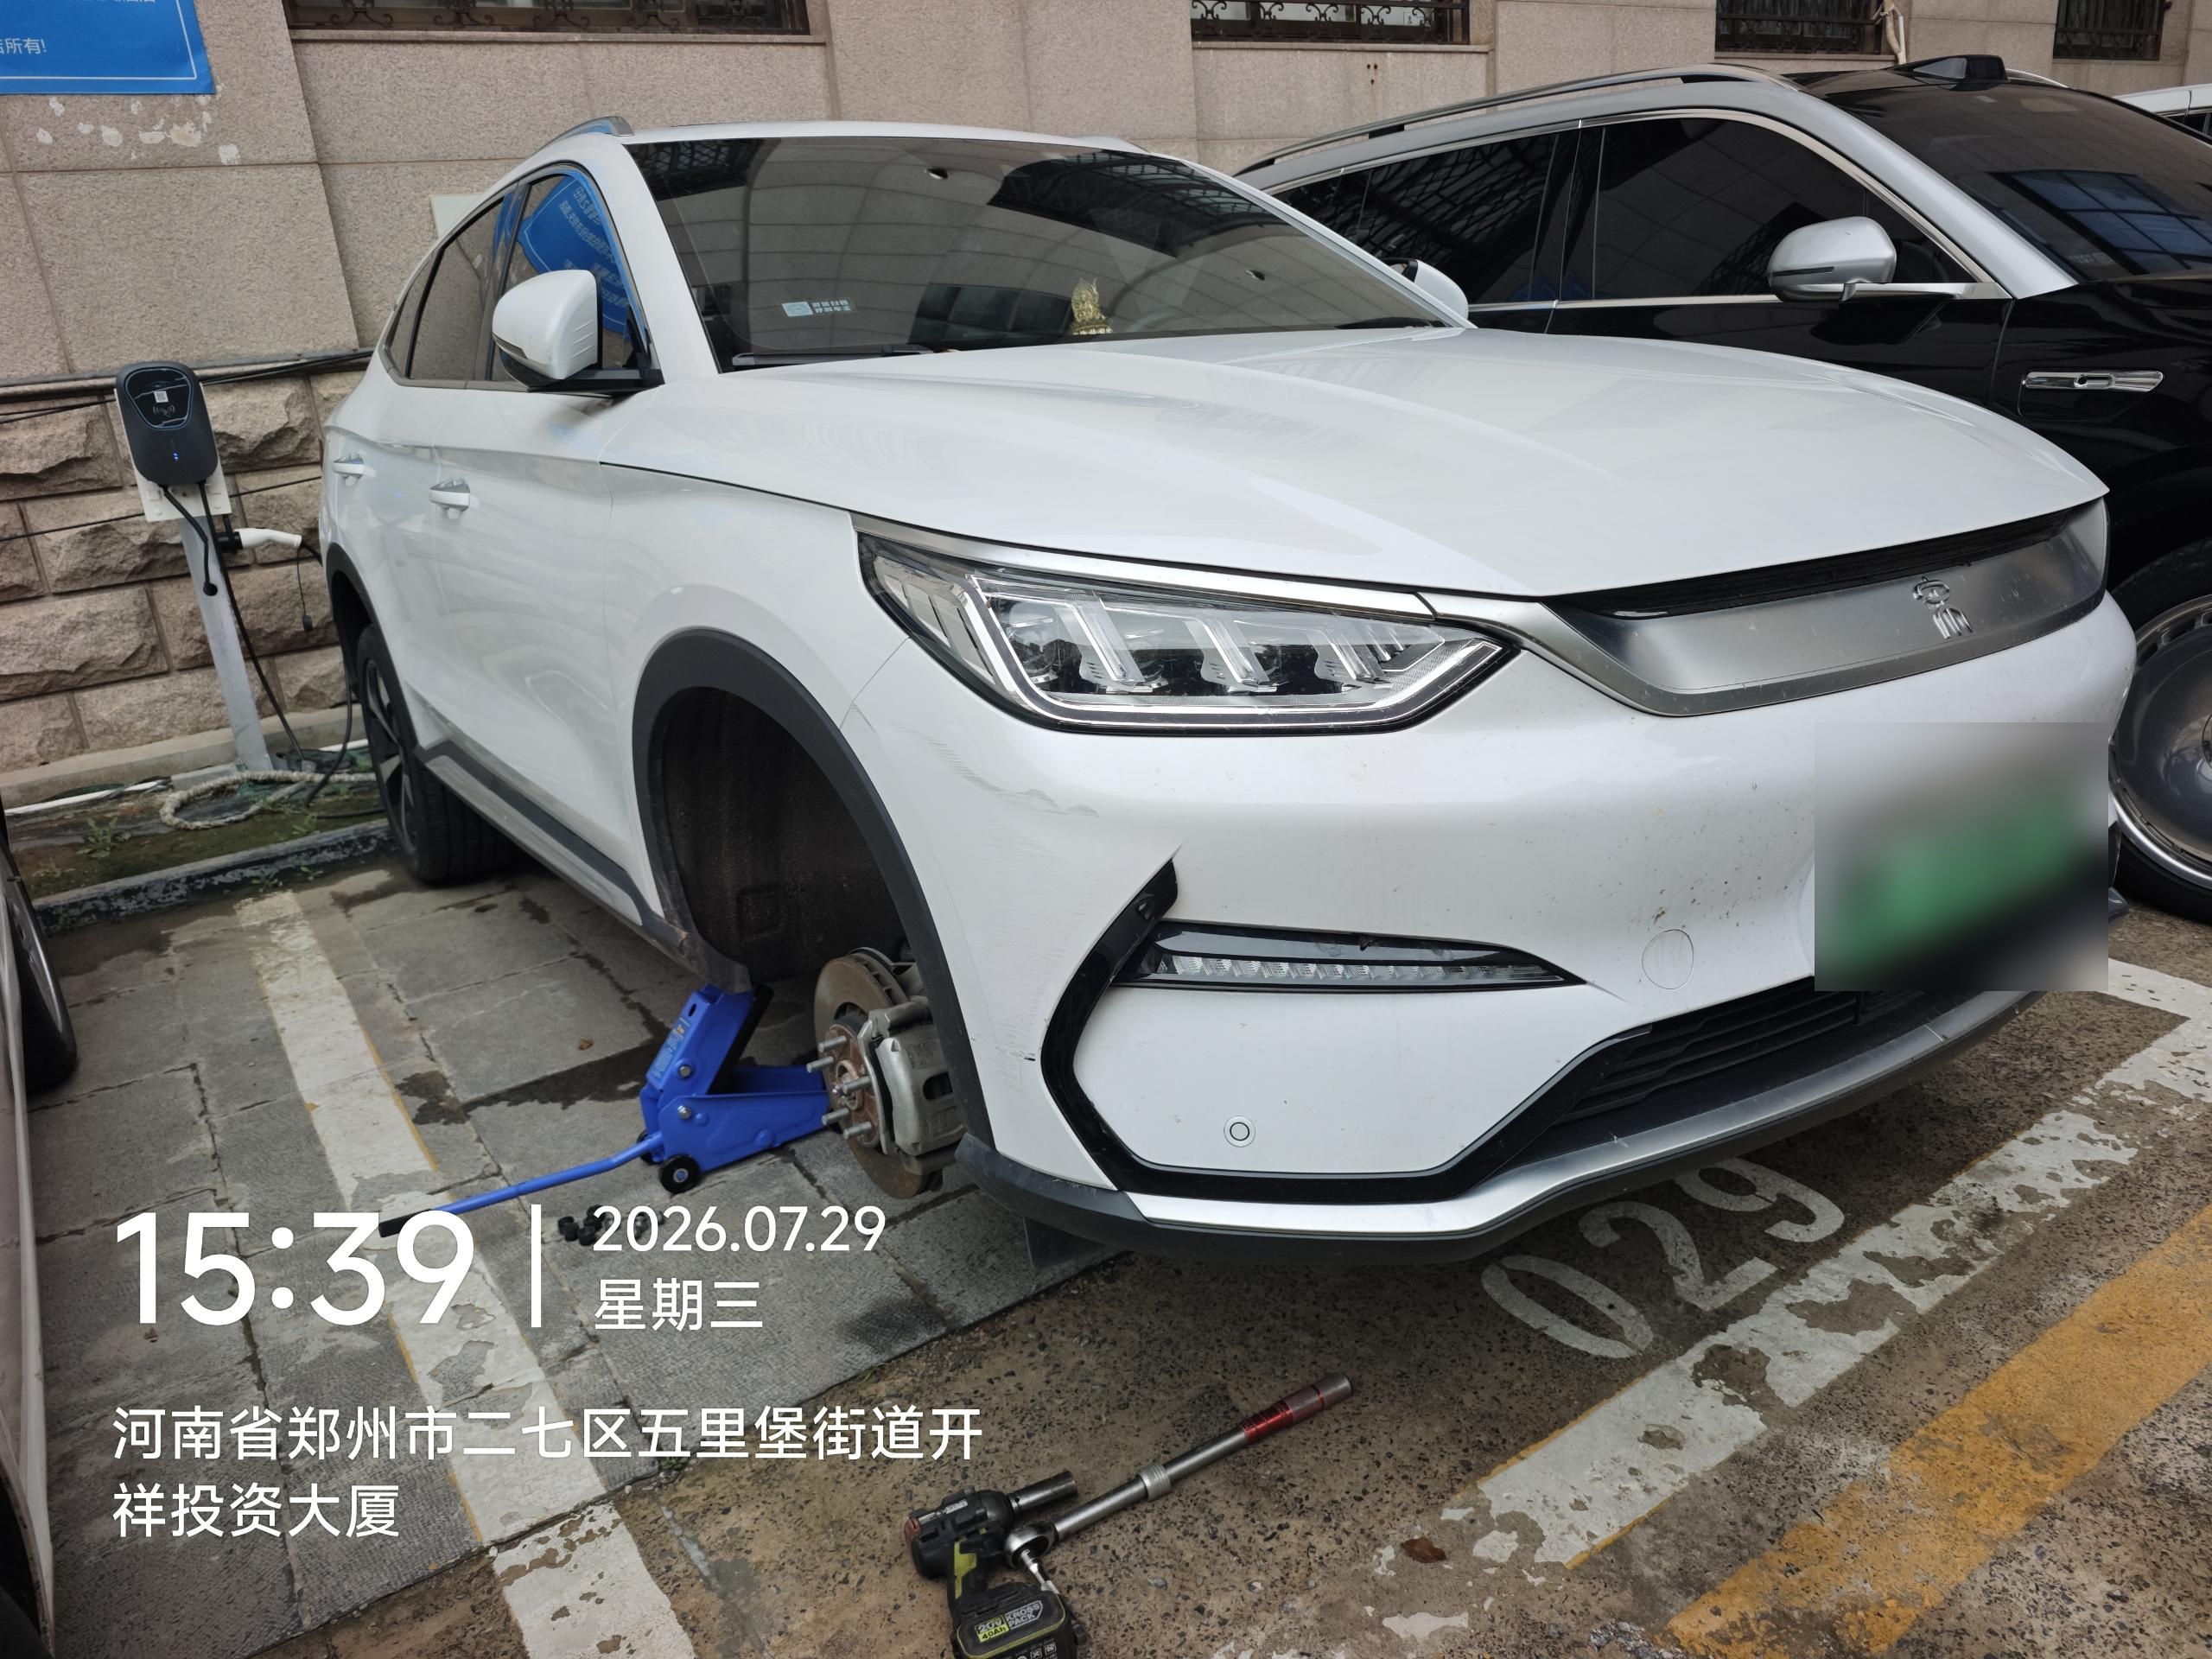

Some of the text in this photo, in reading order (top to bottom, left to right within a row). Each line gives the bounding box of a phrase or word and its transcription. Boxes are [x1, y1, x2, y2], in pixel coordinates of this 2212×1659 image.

[1481, 1158, 1845, 1358] 029
[1005, 1603, 1039, 1622] KROSS
[1007, 1612, 1035, 1629] PACK
